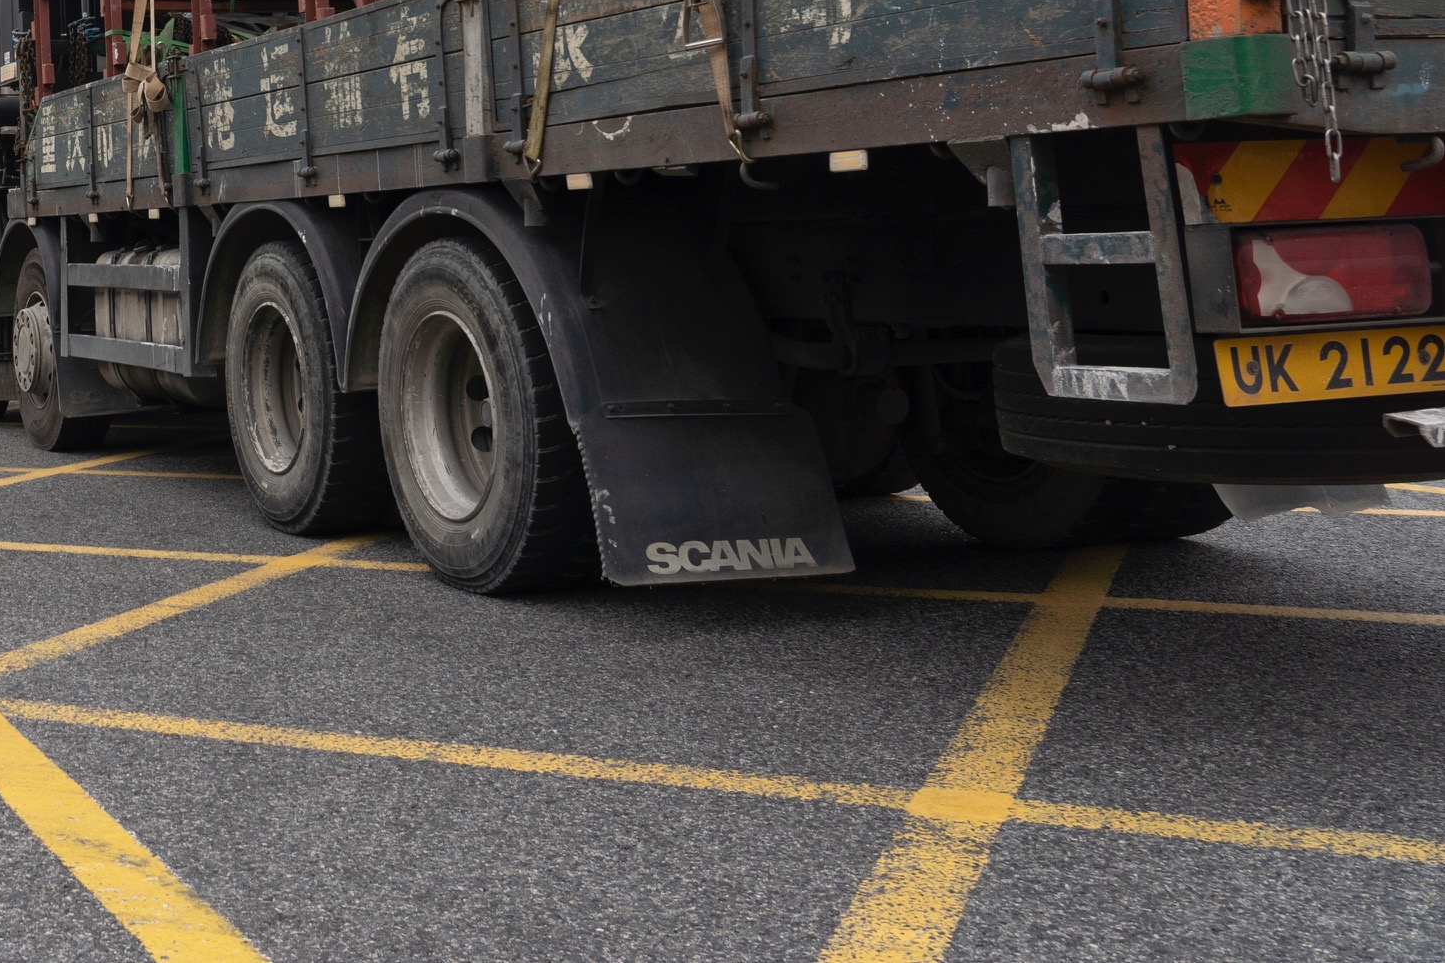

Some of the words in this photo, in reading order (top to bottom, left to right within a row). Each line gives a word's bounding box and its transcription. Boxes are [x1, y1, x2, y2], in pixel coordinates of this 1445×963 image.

[1229, 343, 1300, 394] UK
[1319, 333, 1445, 391] 2122
[645, 537, 820, 575] SCANIA
